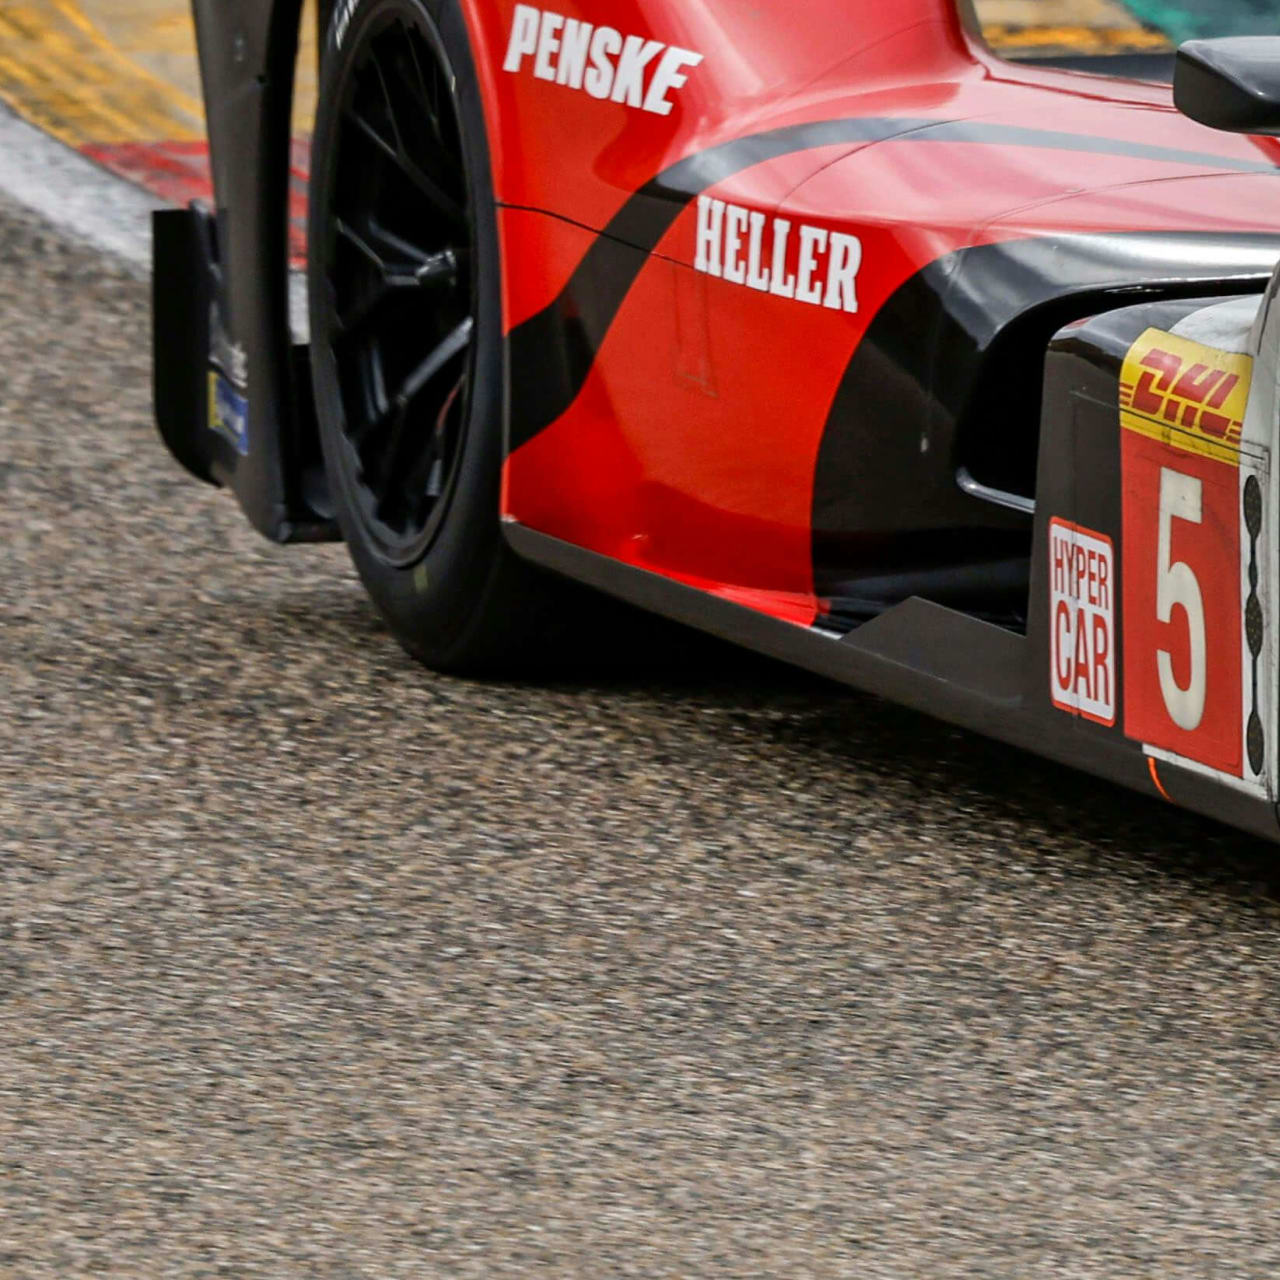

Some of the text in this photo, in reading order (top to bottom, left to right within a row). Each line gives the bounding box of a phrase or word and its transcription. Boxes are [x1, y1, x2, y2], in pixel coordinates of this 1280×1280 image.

[503, 3, 704, 116] PENSKE
[694, 195, 863, 314] HELLER
[1052, 534, 1109, 610] HYPER
[1156, 466, 1207, 732] 5
[1055, 599, 1110, 707] CAR
